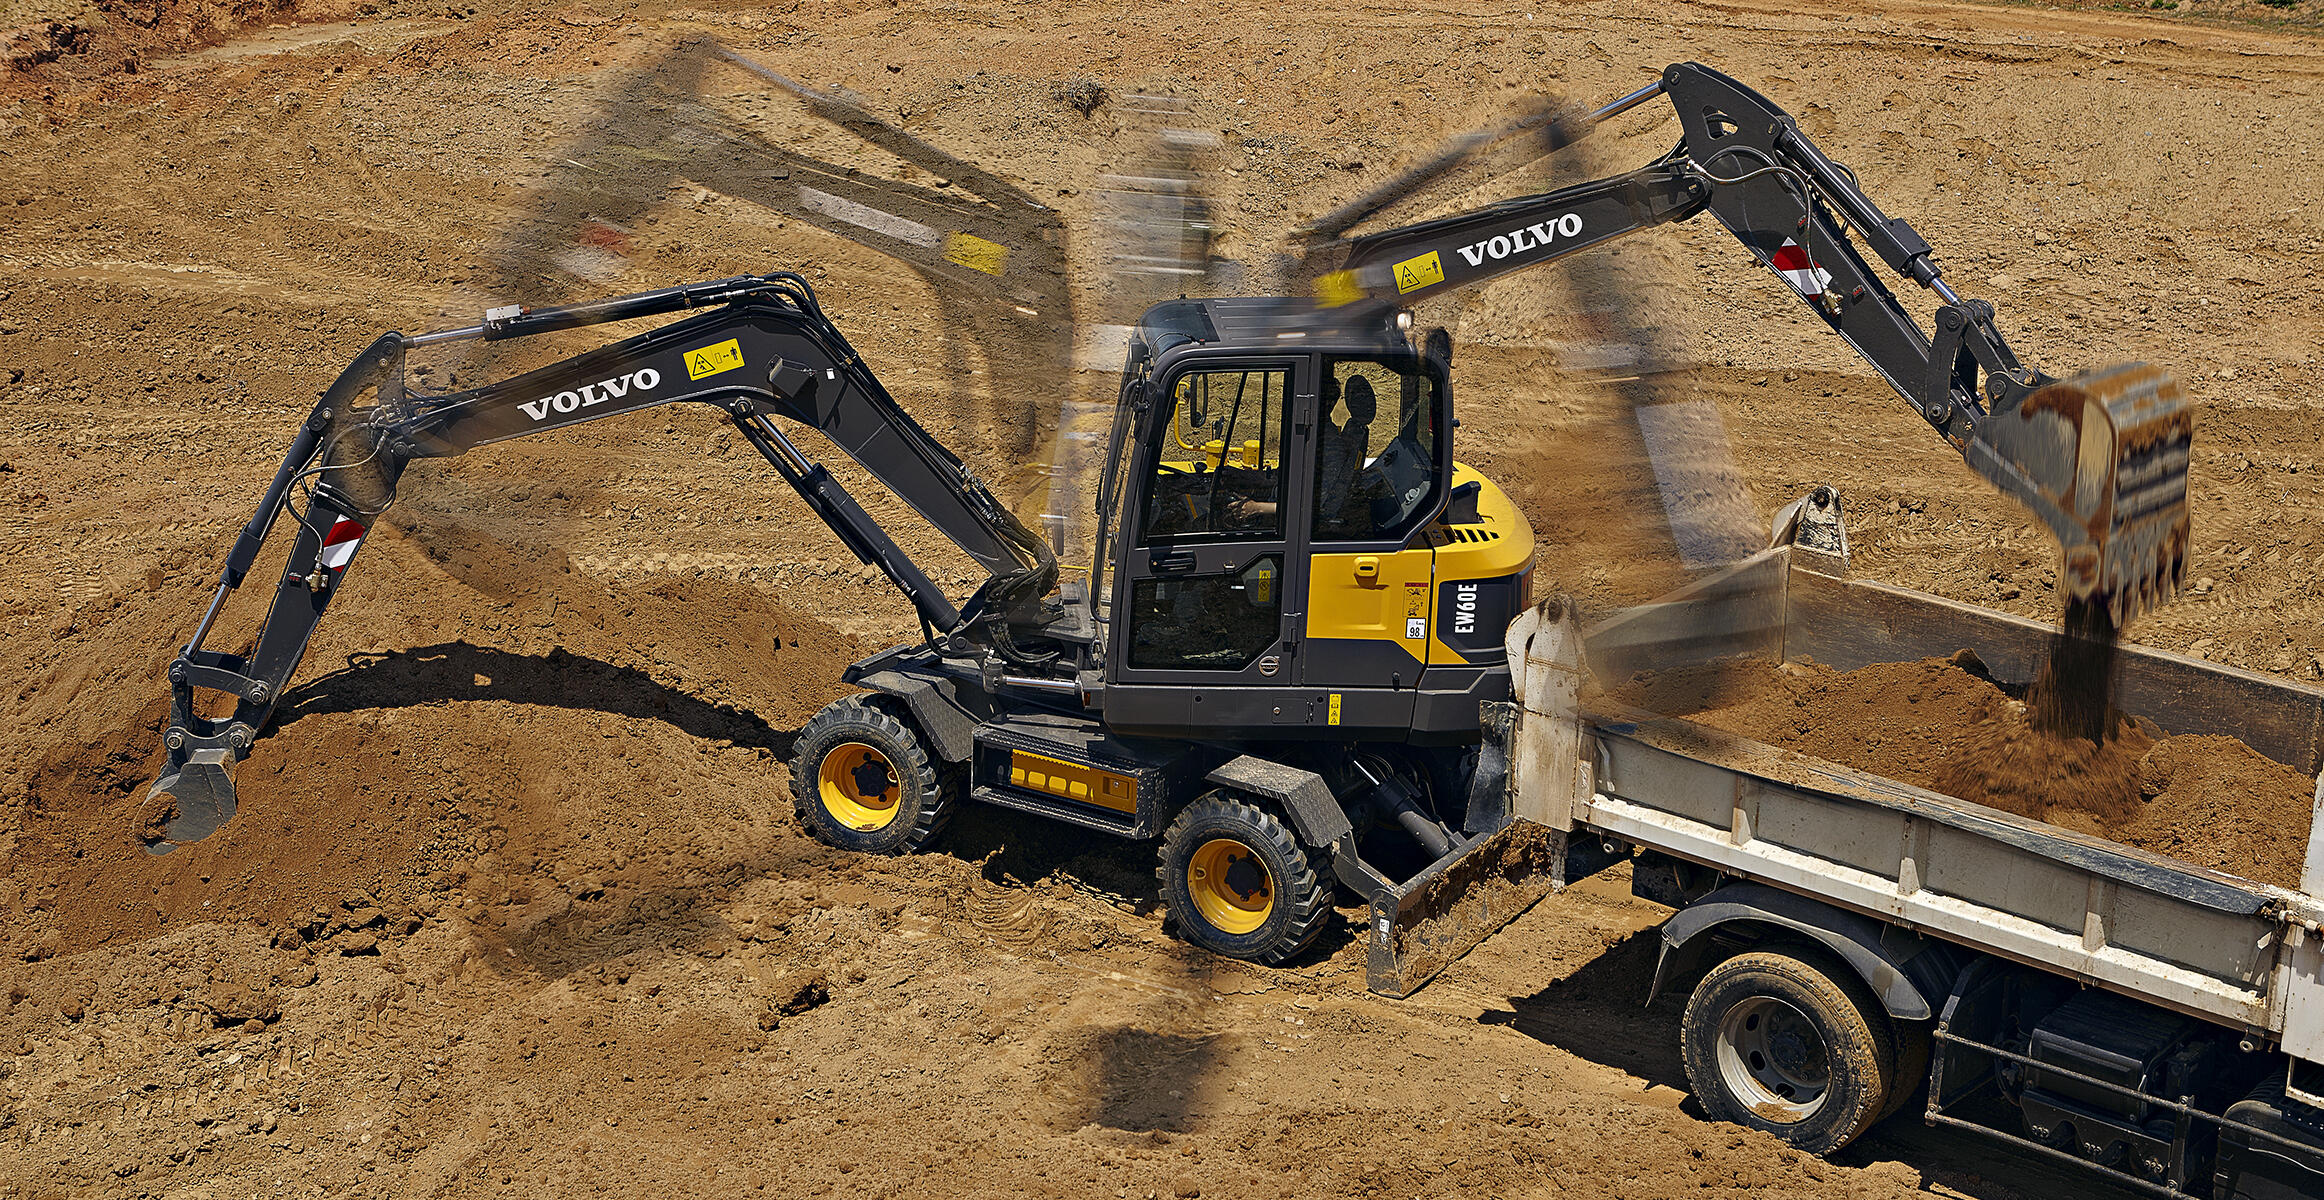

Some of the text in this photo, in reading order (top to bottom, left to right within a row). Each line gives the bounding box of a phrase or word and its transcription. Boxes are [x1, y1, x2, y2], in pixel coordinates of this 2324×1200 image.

[1456, 213, 1583, 267] VOLVO
[516, 368, 661, 421] VOLVO
[1409, 626, 1420, 638] 98
[1454, 583, 1478, 634] EW60E
